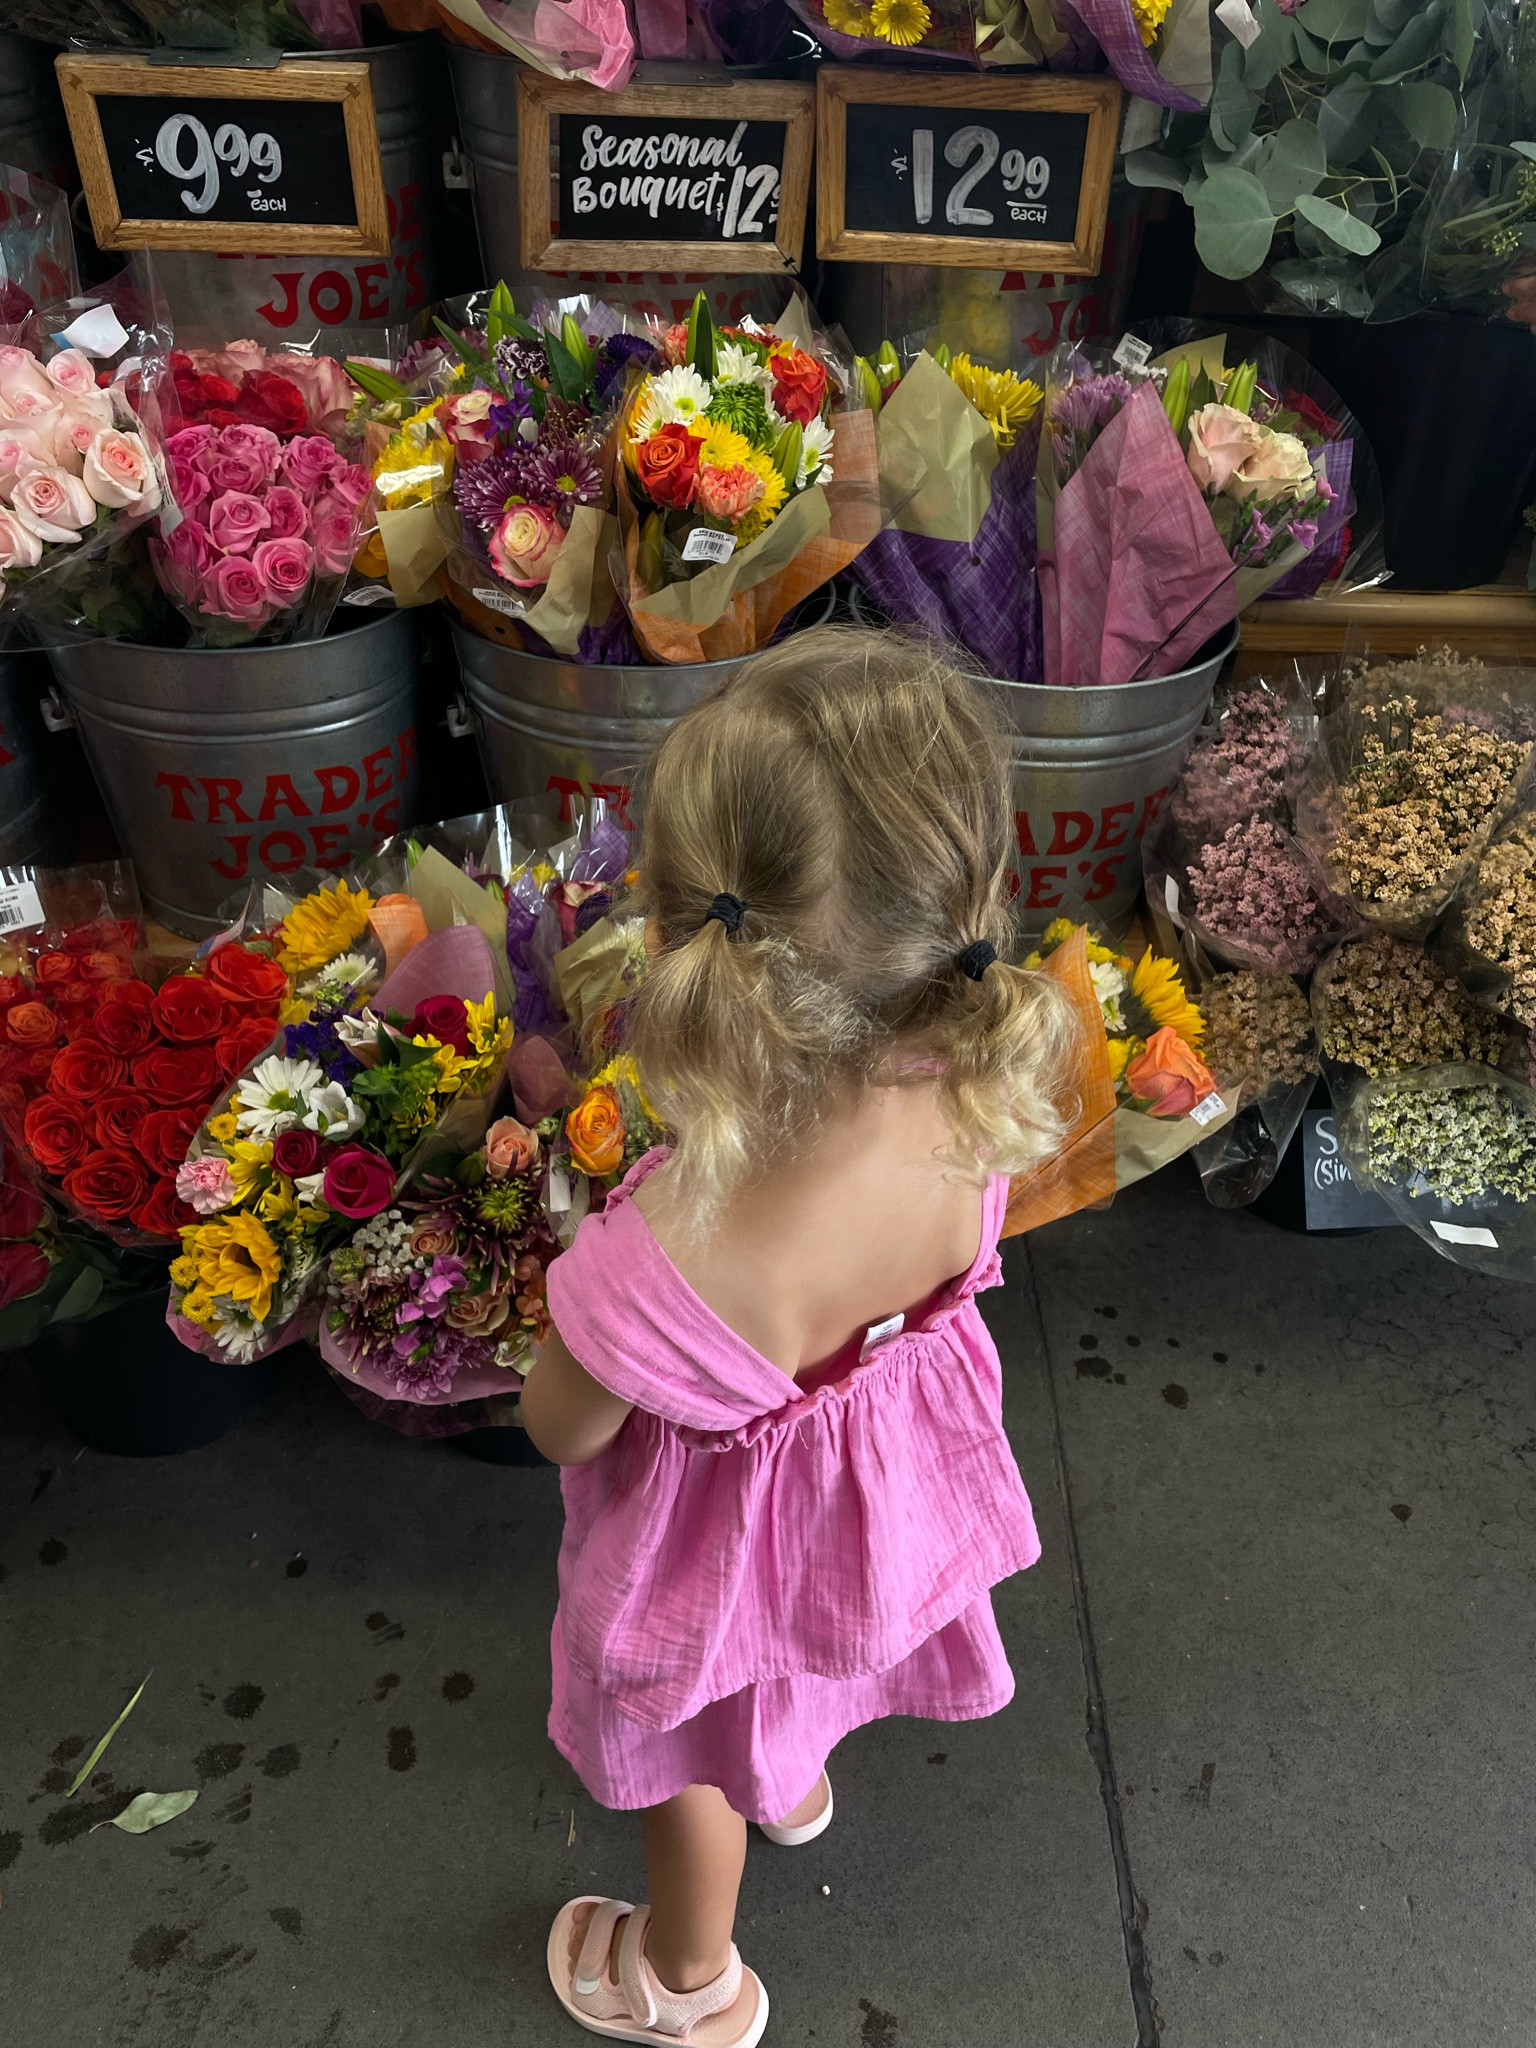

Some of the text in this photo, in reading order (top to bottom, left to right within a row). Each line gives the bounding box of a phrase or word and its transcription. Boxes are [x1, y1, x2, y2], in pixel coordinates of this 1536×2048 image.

[580, 121, 748, 172] Seasonal
[572, 171, 726, 218] Bouquet
[256, 251, 426, 328] JOE'S
[156, 724, 418, 824] TRADER
